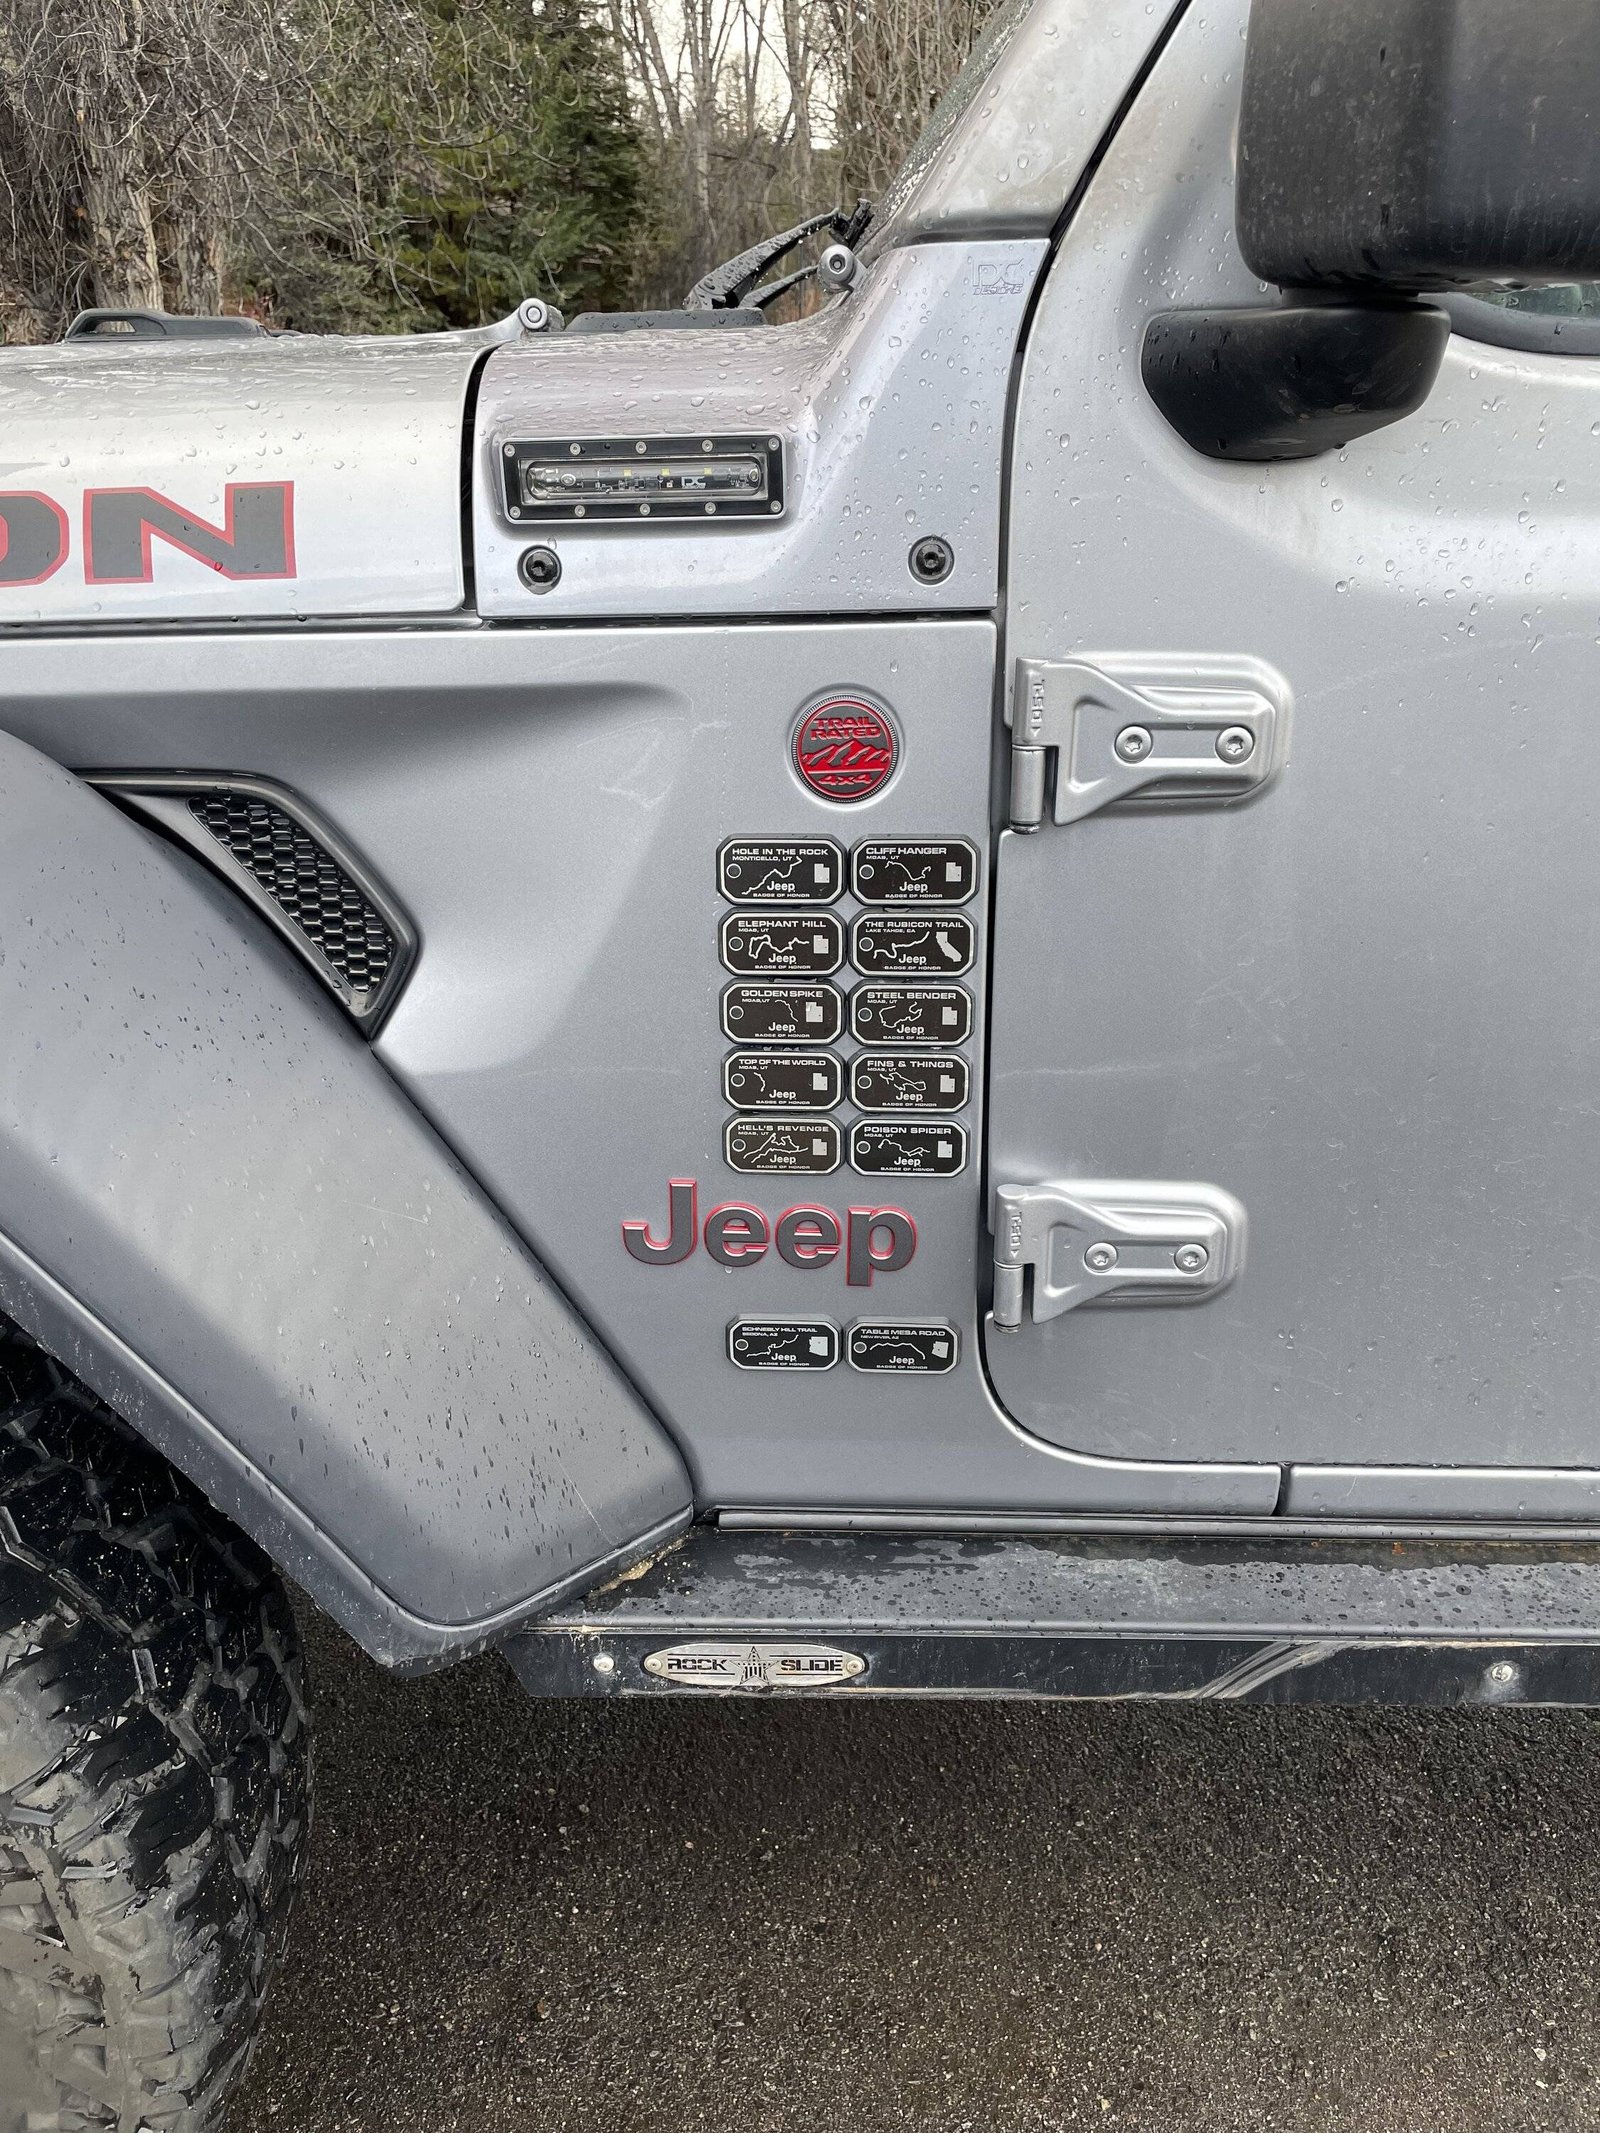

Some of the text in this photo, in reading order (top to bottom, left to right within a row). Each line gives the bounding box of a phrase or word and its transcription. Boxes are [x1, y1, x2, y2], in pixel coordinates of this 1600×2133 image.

[813, 716, 877, 730] TRAIL
[810, 727, 880, 741] RATED
[767, 881, 795, 892] Jeep
[899, 881, 928, 893] Jeep
[768, 953, 796, 964] Jeep
[899, 954, 927, 965] Jeep
[768, 1022, 796, 1033] Jeep
[897, 1024, 925, 1035] Jeep
[769, 1089, 796, 1099] Jeep
[896, 1092, 923, 1102] Jeep
[770, 1154, 796, 1164] Jeep
[894, 1157, 921, 1167] Jeep
[622, 1178, 917, 1287] Jeep
[771, 1353, 796, 1362] Jeep
[889, 1356, 915, 1365] Jeep
[667, 1658, 843, 1672] ROCK SLIDE
